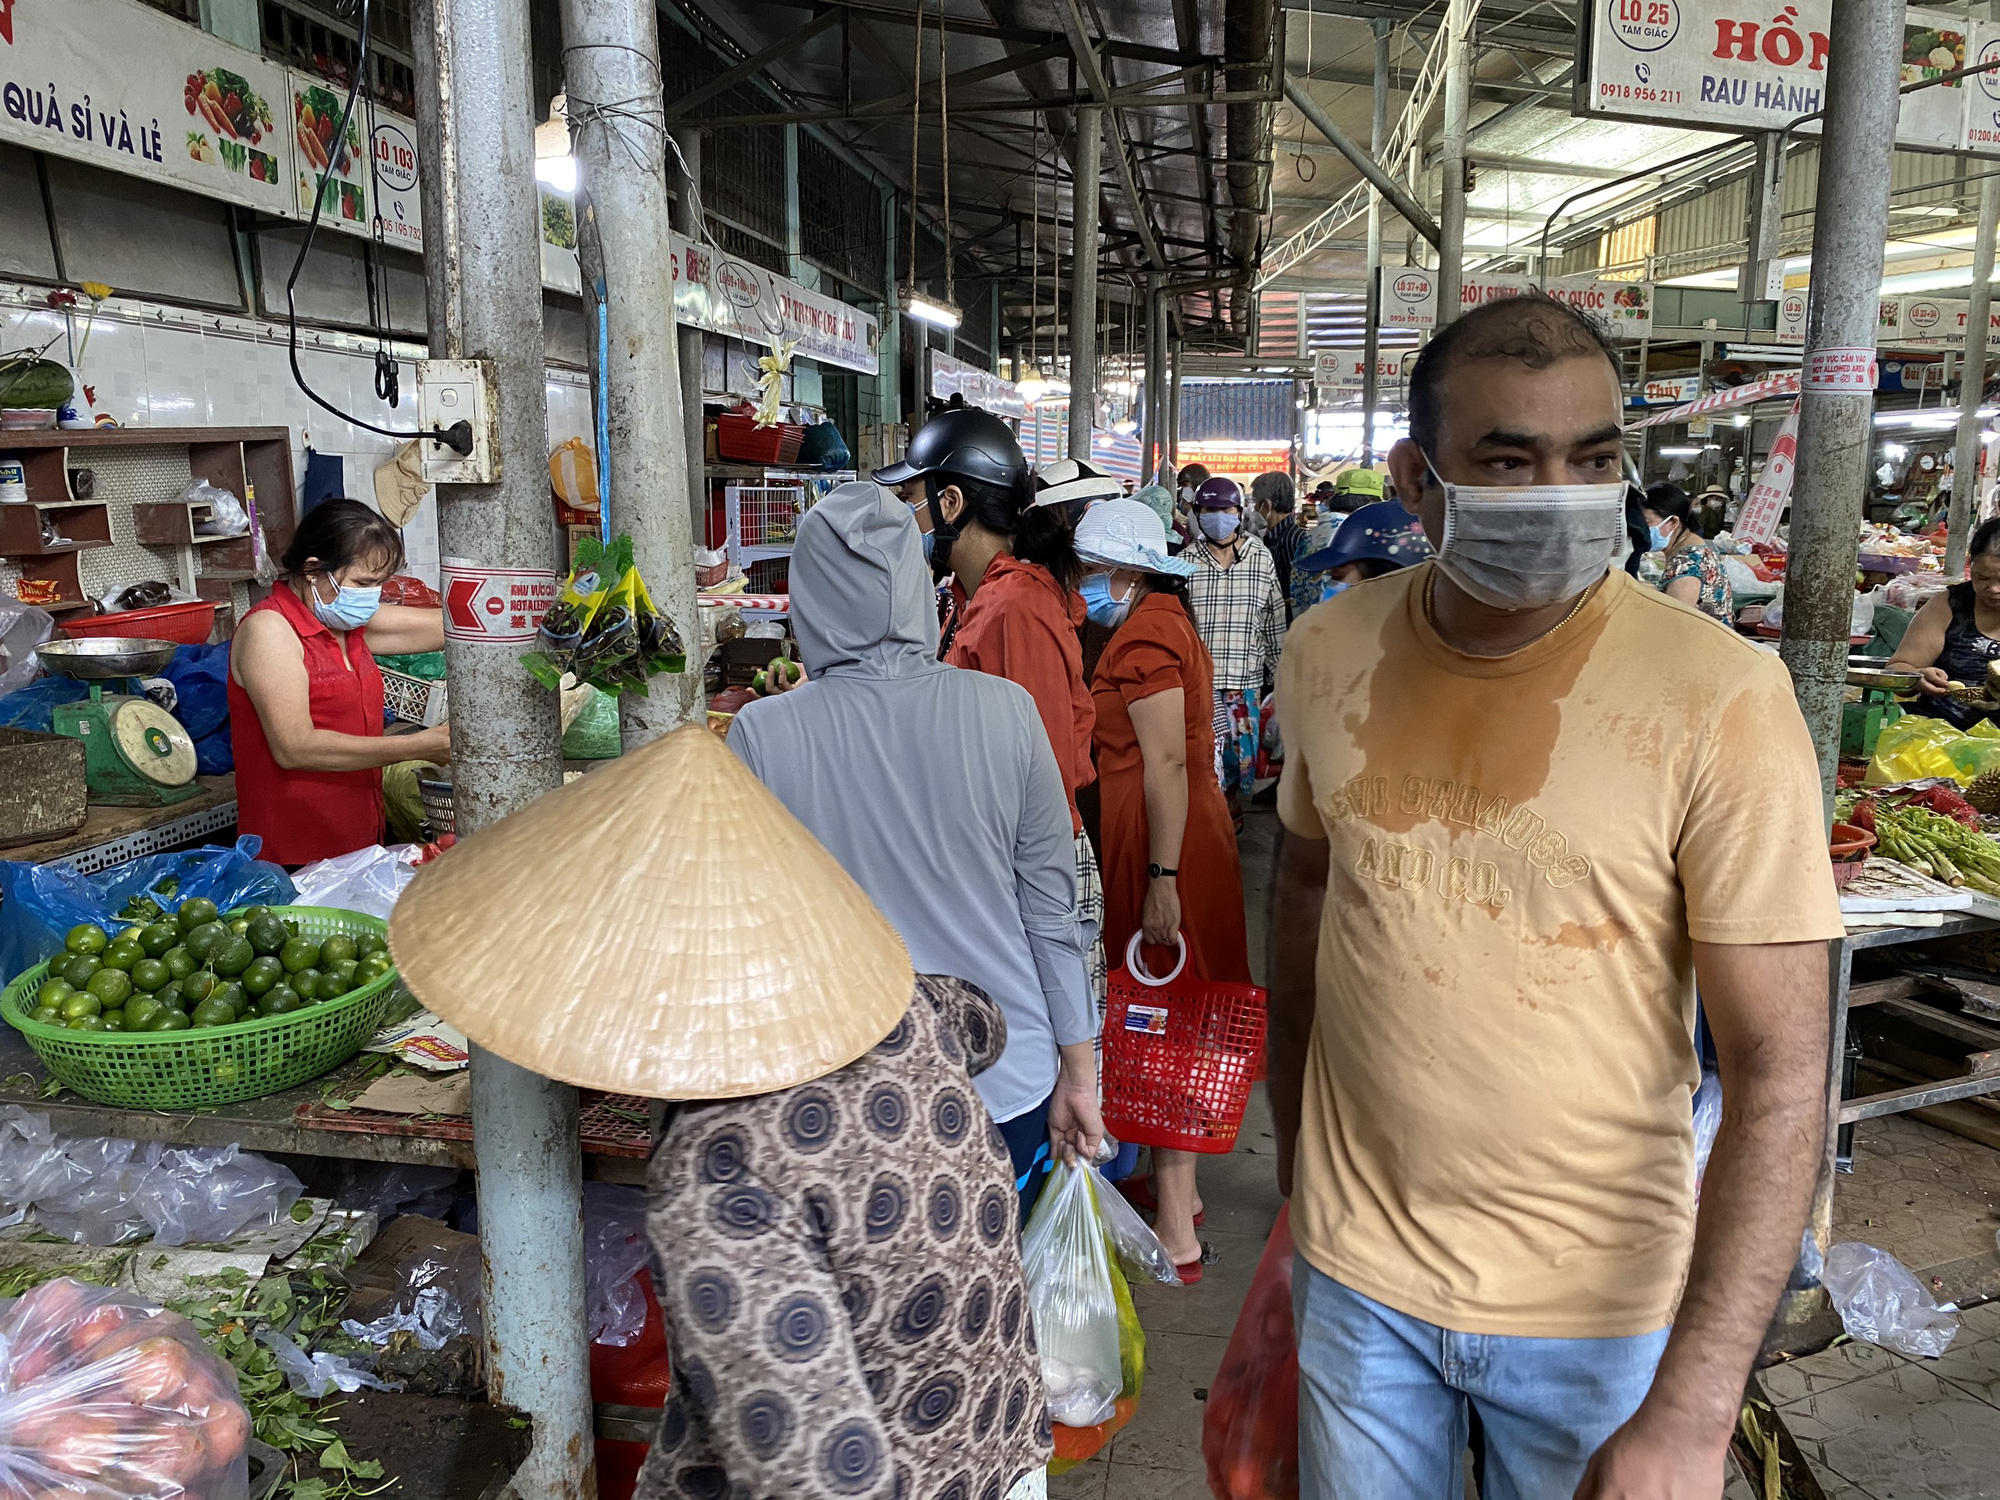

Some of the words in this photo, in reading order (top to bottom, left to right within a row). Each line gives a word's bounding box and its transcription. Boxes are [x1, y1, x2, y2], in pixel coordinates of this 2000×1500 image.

[1647, 2, 1669, 25] 25
[1622, 25, 1641, 35] TAM
[1644, 26, 1668, 38] GIÁC
[1986, 77, 1998, 86] TAM
[1600, 83, 1630, 98] 0918
[1634, 87, 1656, 101] 956
[1661, 89, 1681, 103] 211
[1700, 75, 1747, 105] RAU
[1754, 76, 1820, 113] HÀNH
[3, 82, 64, 132] QUẢ
[71, 95, 93, 141] SỈ
[99, 108, 135, 154] VÀ
[141, 118, 163, 163] LẺ
[1969, 129, 1991, 141] 01200
[375, 136, 389, 161] LÔ
[393, 145, 414, 171] 103
[381, 163, 395, 176] TAM
[395, 169, 412, 181] GIÁC
[374, 218, 393, 233] 005
[395, 222, 408, 237] 195
[409, 226, 421, 241] 732
[1397, 279, 1406, 291] LÔ
[1407, 281, 1428, 292] 37+38
[1568, 283, 1605, 310] QUỐC
[1355, 357, 1399, 376] KỀU
[1812, 365, 1822, 373] NOT
[1823, 364, 1850, 373] ALLOWED
[1851, 364, 1865, 373] AREA
[510, 584, 529, 596] KHU
[1400, 775, 1592, 889] STRAUSS
[1354, 836, 1434, 893] AND
